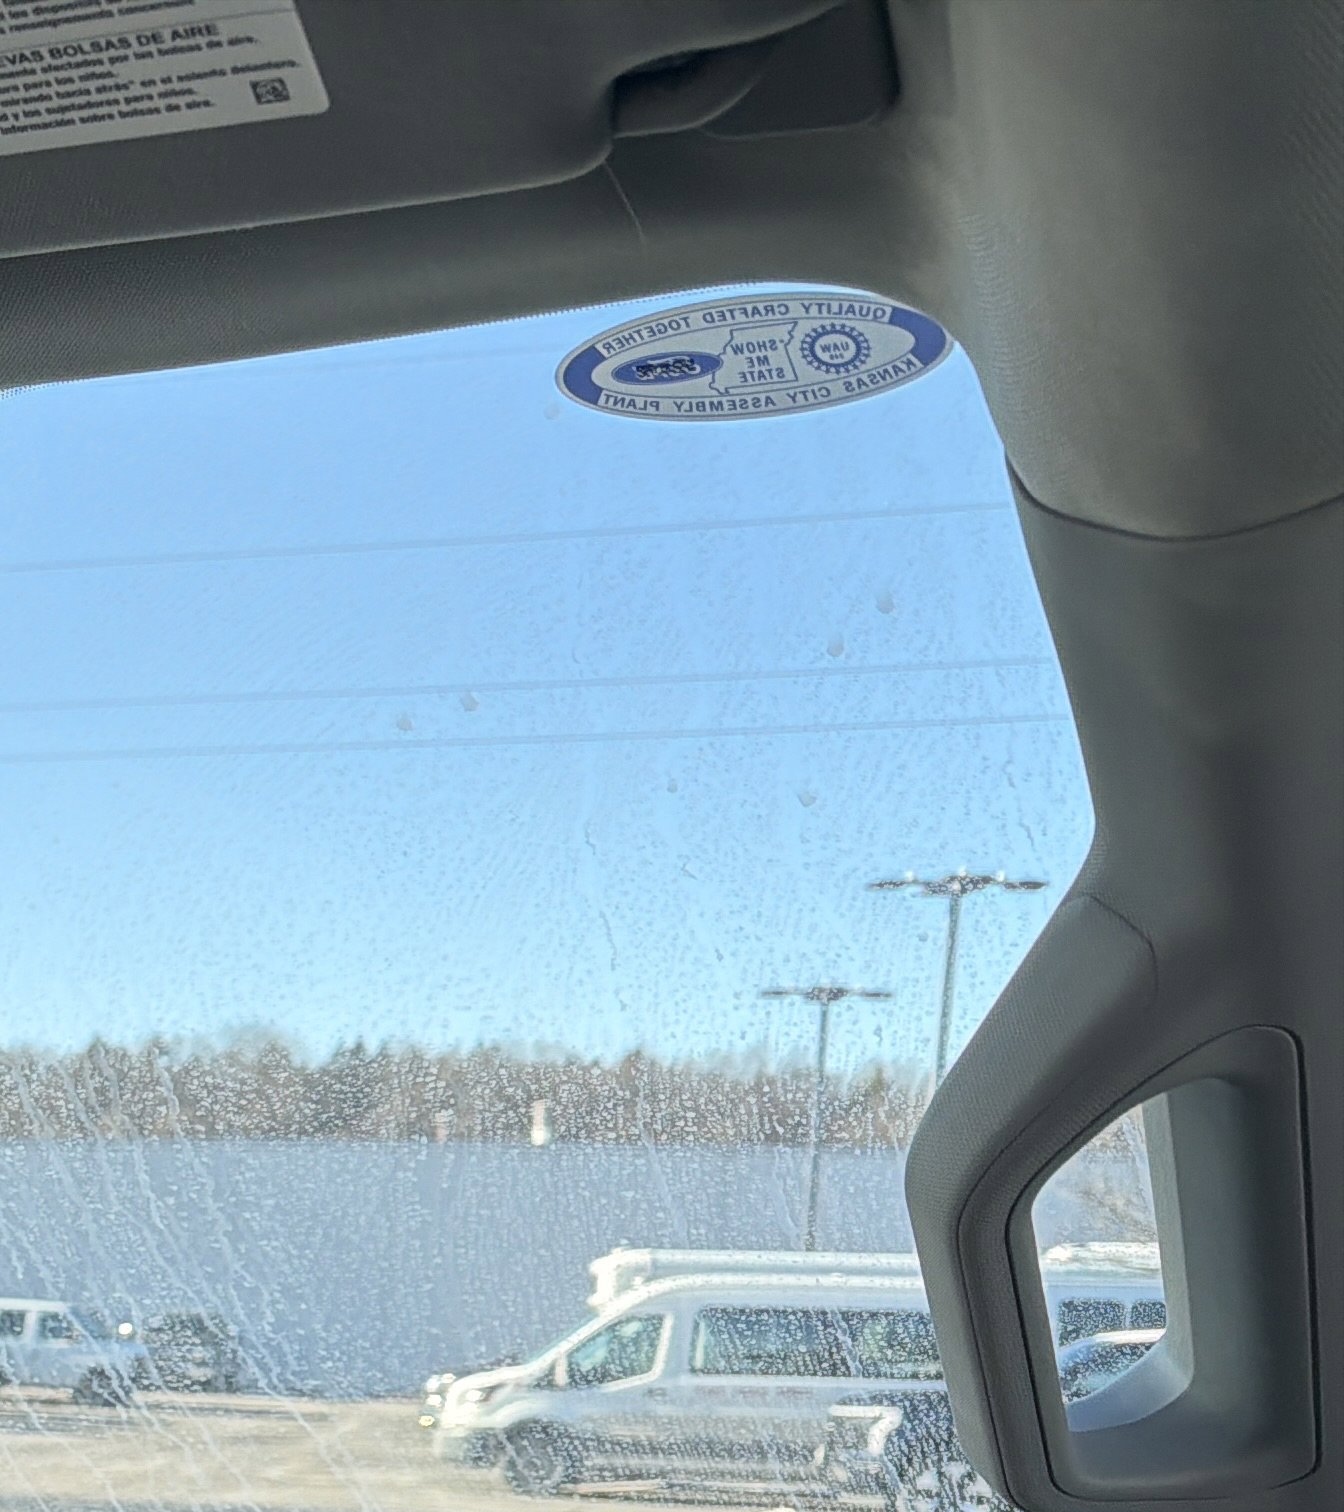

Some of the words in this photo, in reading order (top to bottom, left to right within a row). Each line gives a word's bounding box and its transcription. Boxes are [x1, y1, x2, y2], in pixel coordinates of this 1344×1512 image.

[48, 36, 132, 60] BOLSAS
[135, 31, 166, 48] DE
[170, 23, 220, 43] AIRE
